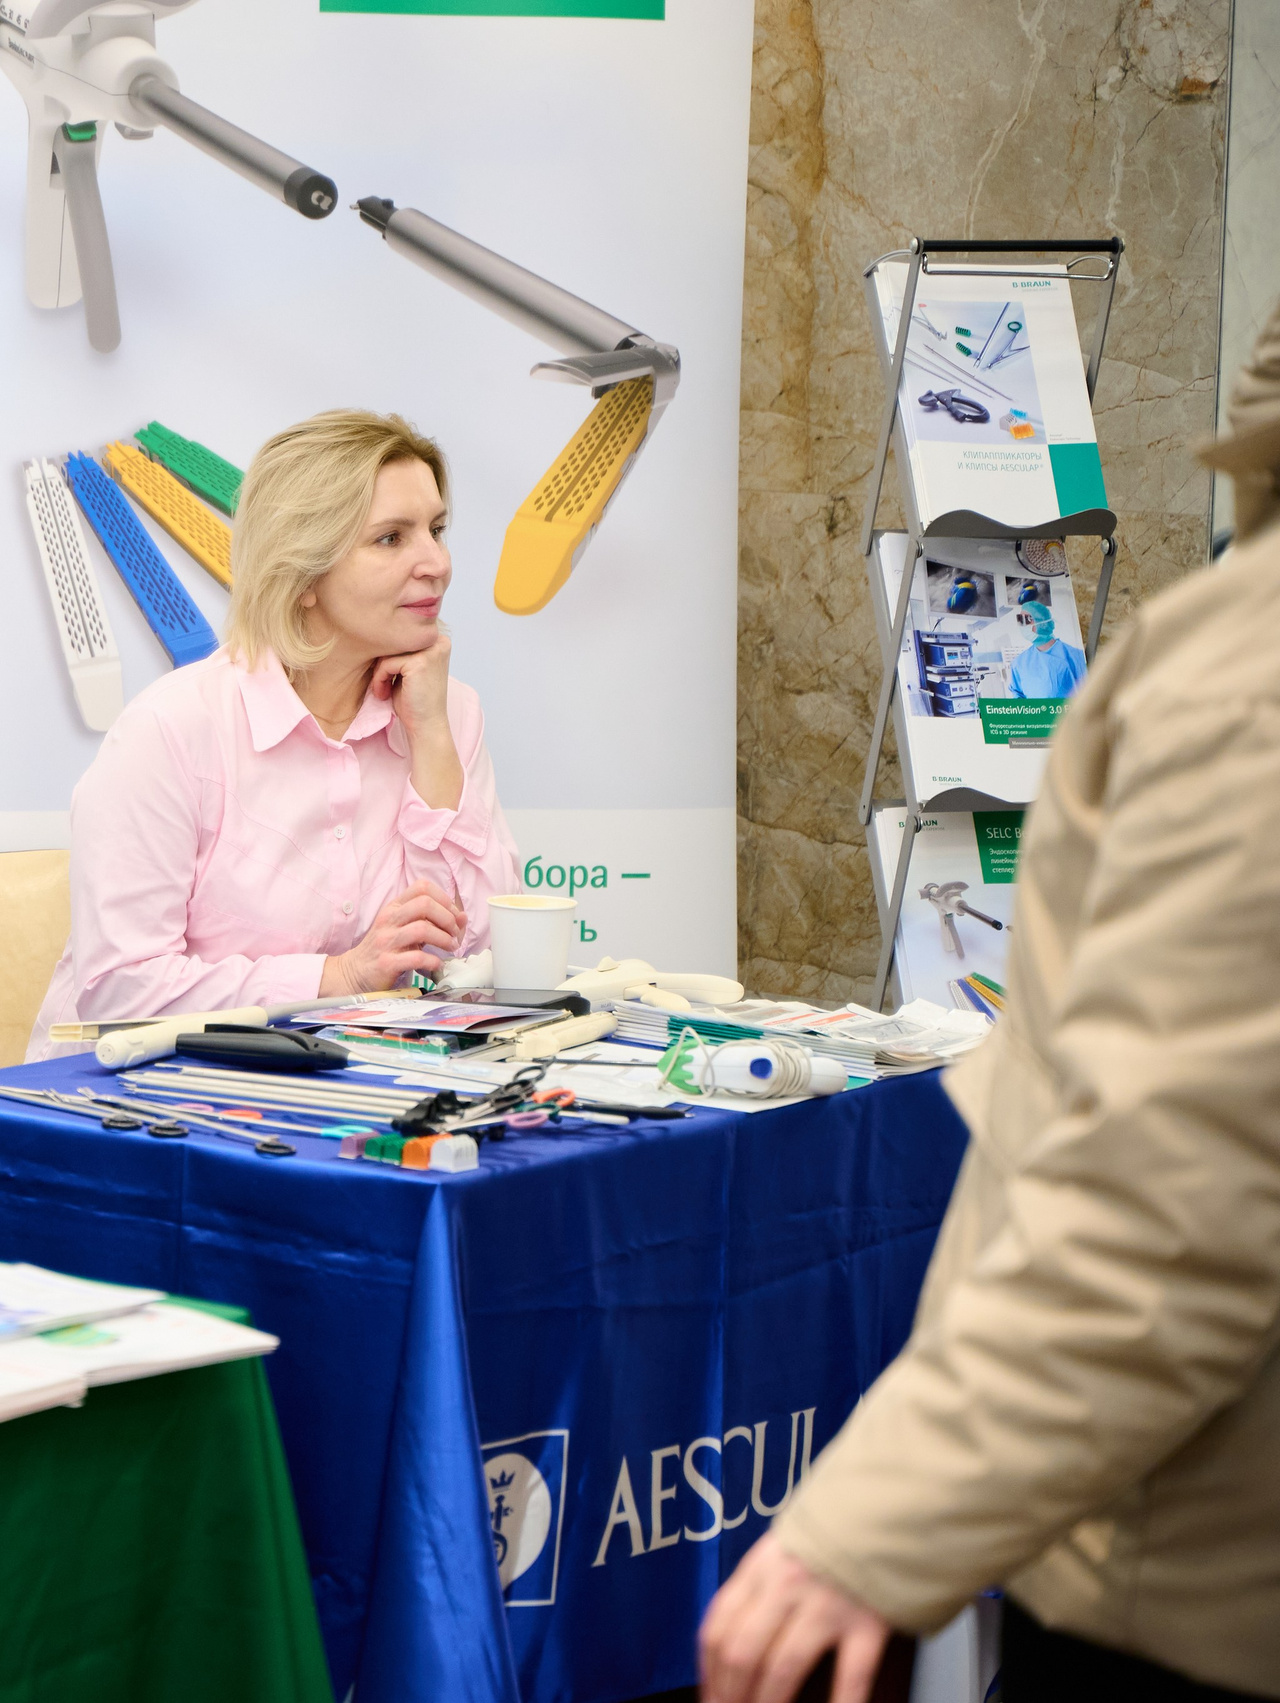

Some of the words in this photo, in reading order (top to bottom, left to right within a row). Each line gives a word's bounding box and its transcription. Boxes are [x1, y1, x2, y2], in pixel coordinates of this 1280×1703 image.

[1020, 280, 1051, 288] BRAUN
[963, 450, 1042, 461] КЛИПАППЛИКАТОРЫ
[966, 462, 998, 471] КЛИПСЫ
[985, 827, 1012, 839] SELC
